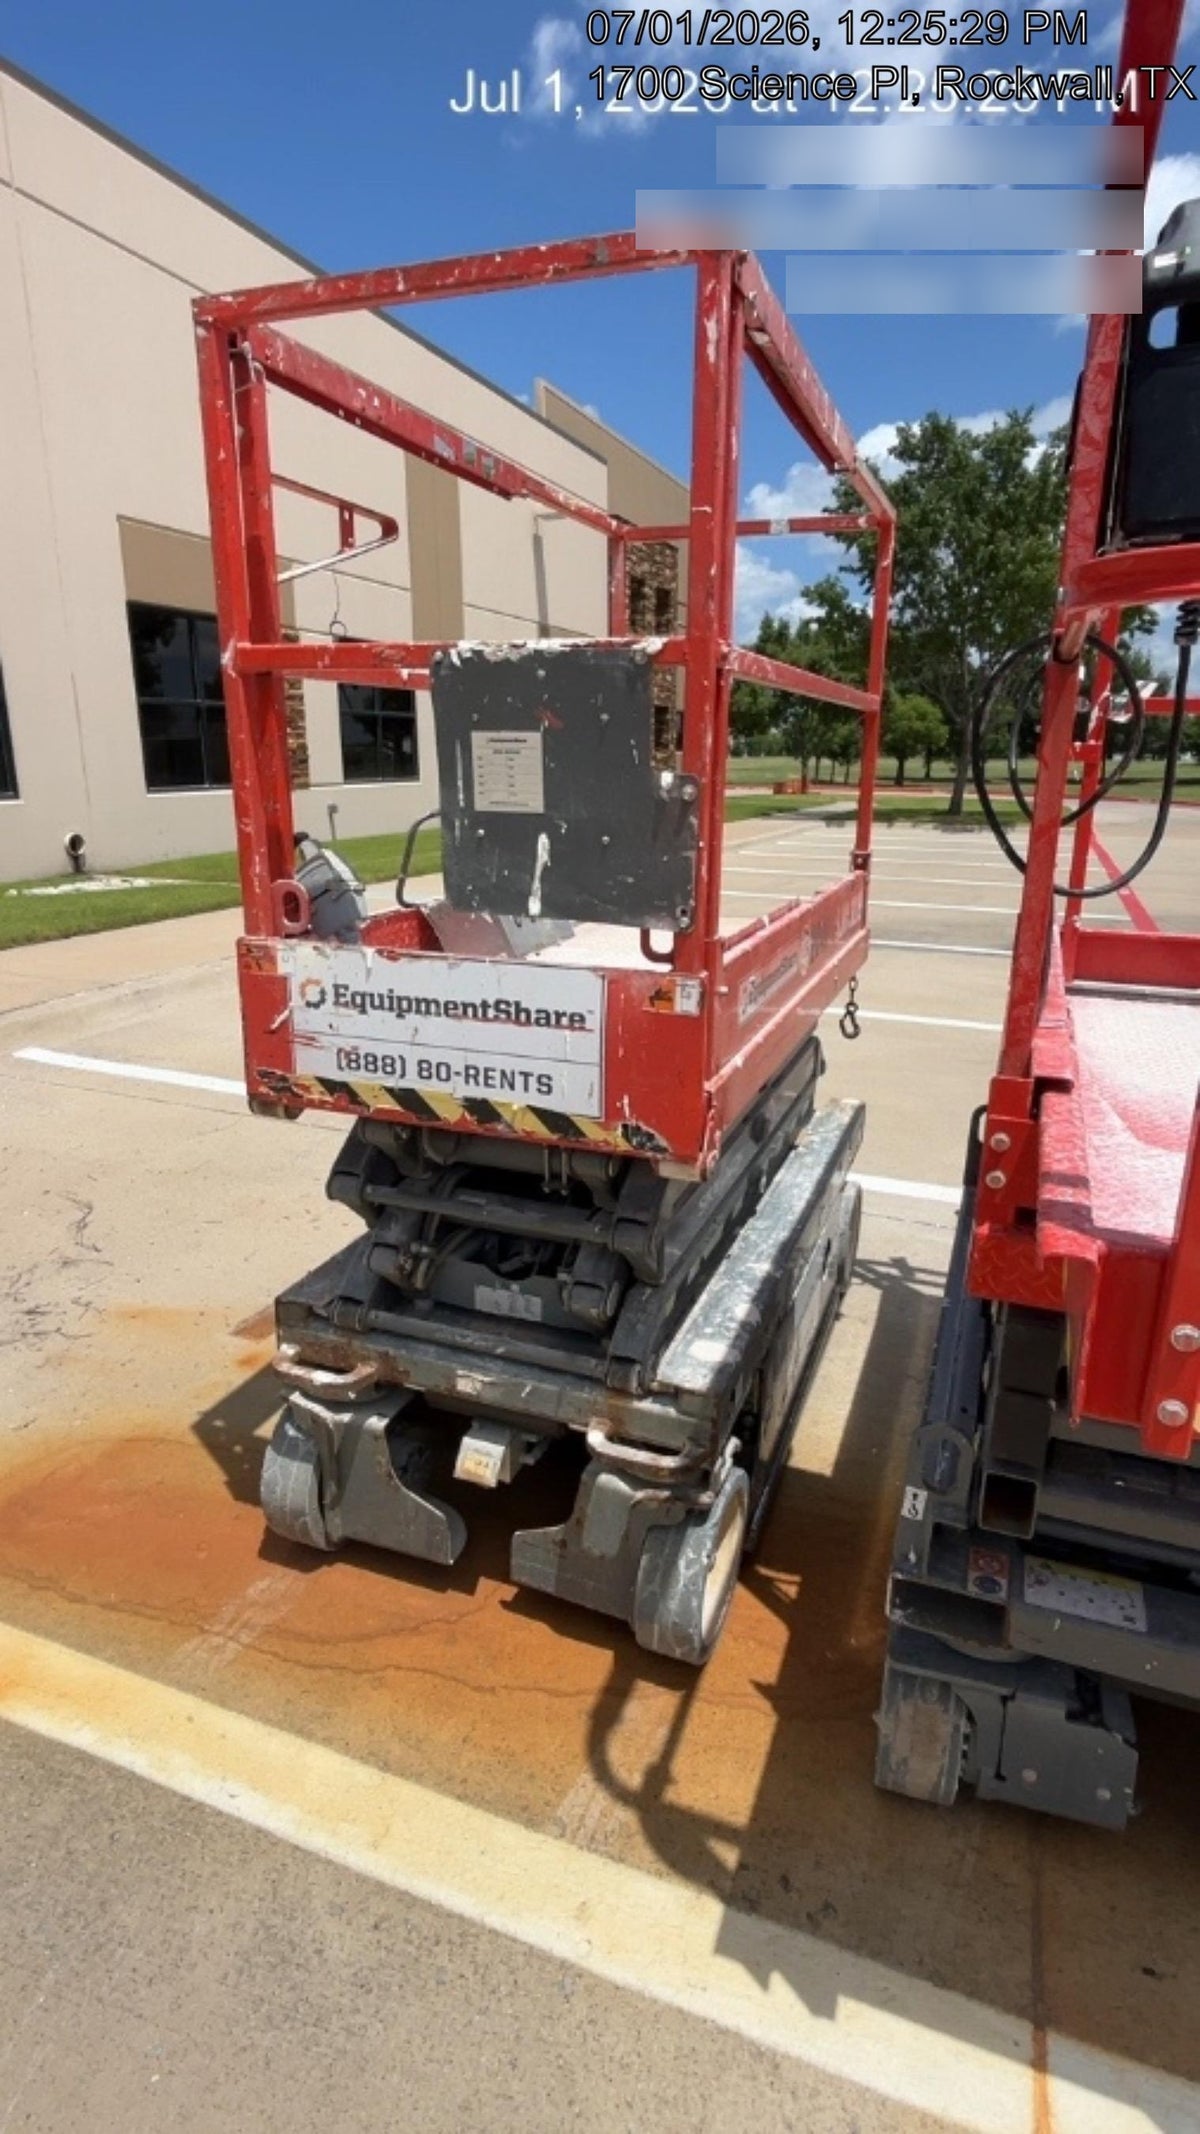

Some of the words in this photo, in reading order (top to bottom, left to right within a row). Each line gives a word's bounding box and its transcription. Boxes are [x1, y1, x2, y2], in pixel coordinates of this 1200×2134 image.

[332, 984, 587, 1031] EquipmentShare
[336, 1047, 407, 1080] (888)
[416, 1058, 554, 1097] 80-RENTS
